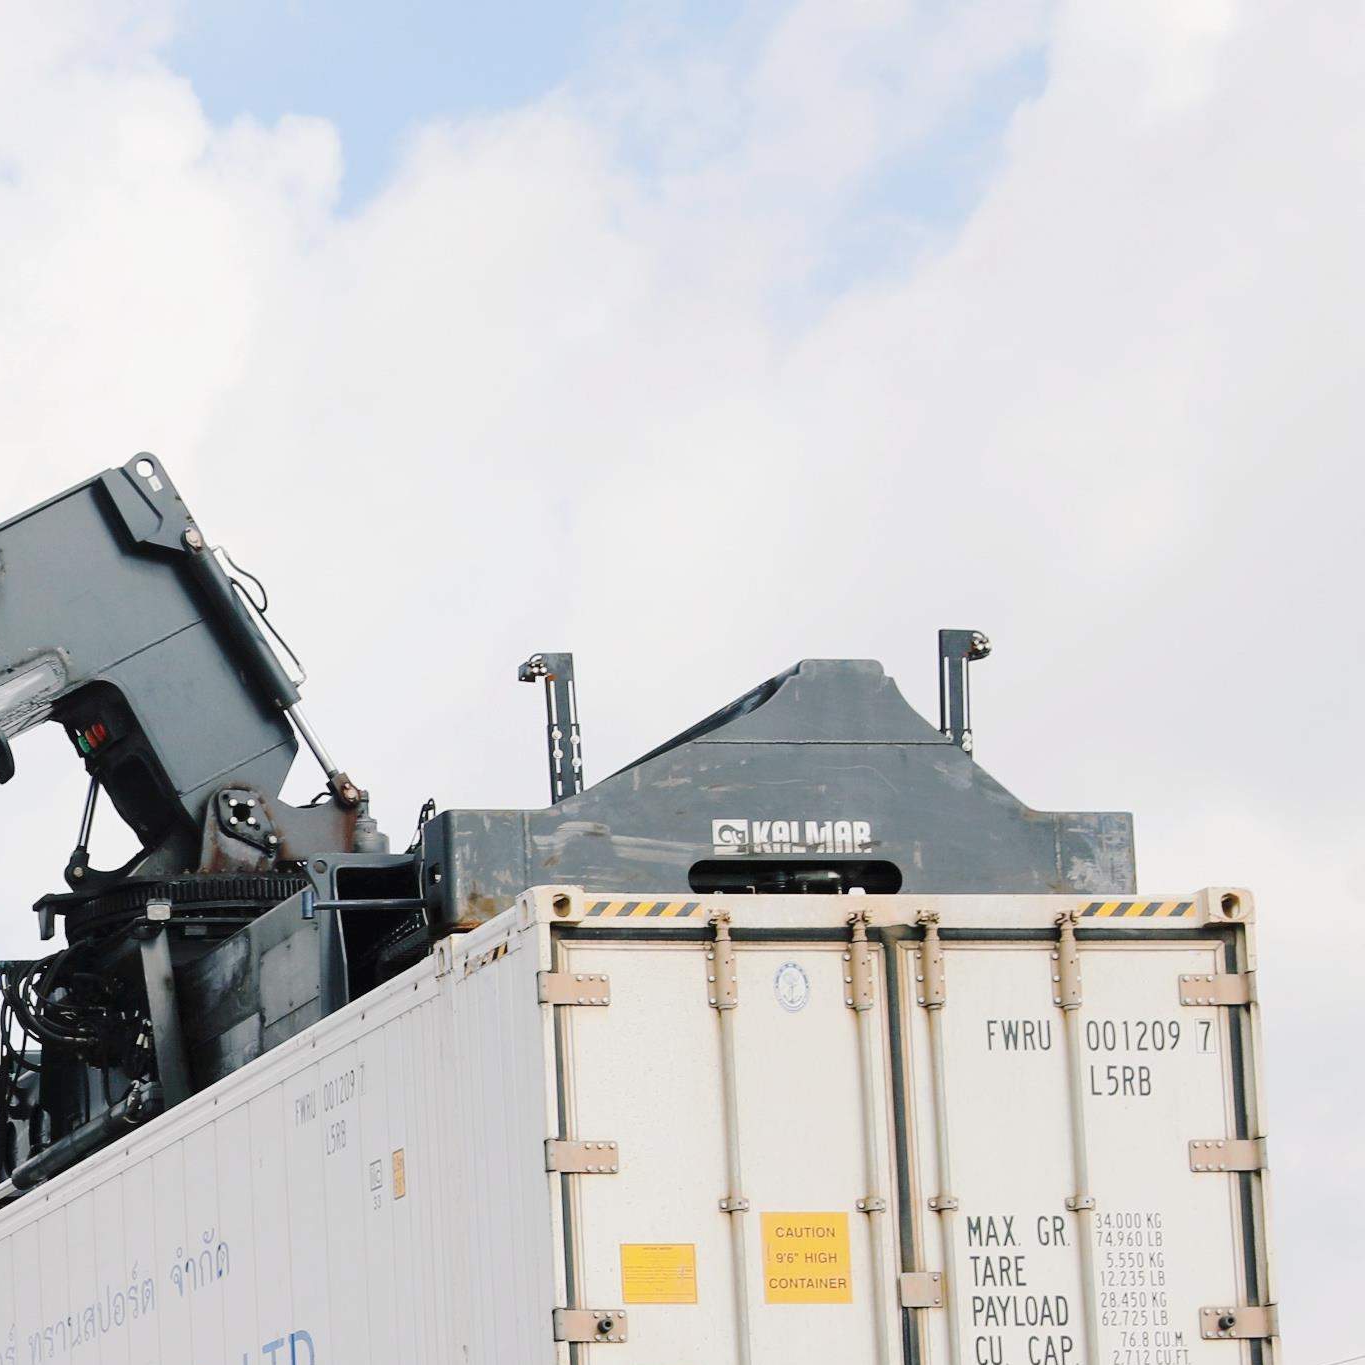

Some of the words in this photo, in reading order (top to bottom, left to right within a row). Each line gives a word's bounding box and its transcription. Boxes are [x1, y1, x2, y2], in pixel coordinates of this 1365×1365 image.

[751, 818, 873, 854] KALMAR
[987, 1019, 1052, 1051] FWRU
[1086, 1020, 1181, 1052] 001209
[1198, 1020, 1211, 1051] 7
[1089, 1065, 1152, 1097] L5RB
[1095, 1212, 1142, 1229] 34.000
[1146, 1212, 1162, 1229] KG
[774, 1226, 836, 1239] CAUTION
[966, 1215, 1021, 1247] MAX.
[1096, 1231, 1143, 1247] 74.960
[1147, 1231, 1163, 1247] LB
[170, 1228, 230, 1296] จำกัด
[804, 1252, 838, 1264] HIGH
[1106, 1252, 1144, 1268] 5.550
[1149, 1252, 1165, 1268] KG
[969, 1255, 1027, 1287] TARE
[1100, 1270, 1145, 1287] 12.235
[1150, 1270, 1166, 1287] LB
[768, 1277, 848, 1290] CONTAINER
[1100, 1291, 1147, 1308] 28.450
[1151, 1291, 1167, 1308] KG
[971, 1295, 1069, 1327] PAYLOAD
[1101, 1310, 1148, 1326] 62.725
[1152, 1310, 1169, 1326] LB
[1120, 1331, 1150, 1348] 76.8
[1113, 1349, 1151, 1365] 2.712
